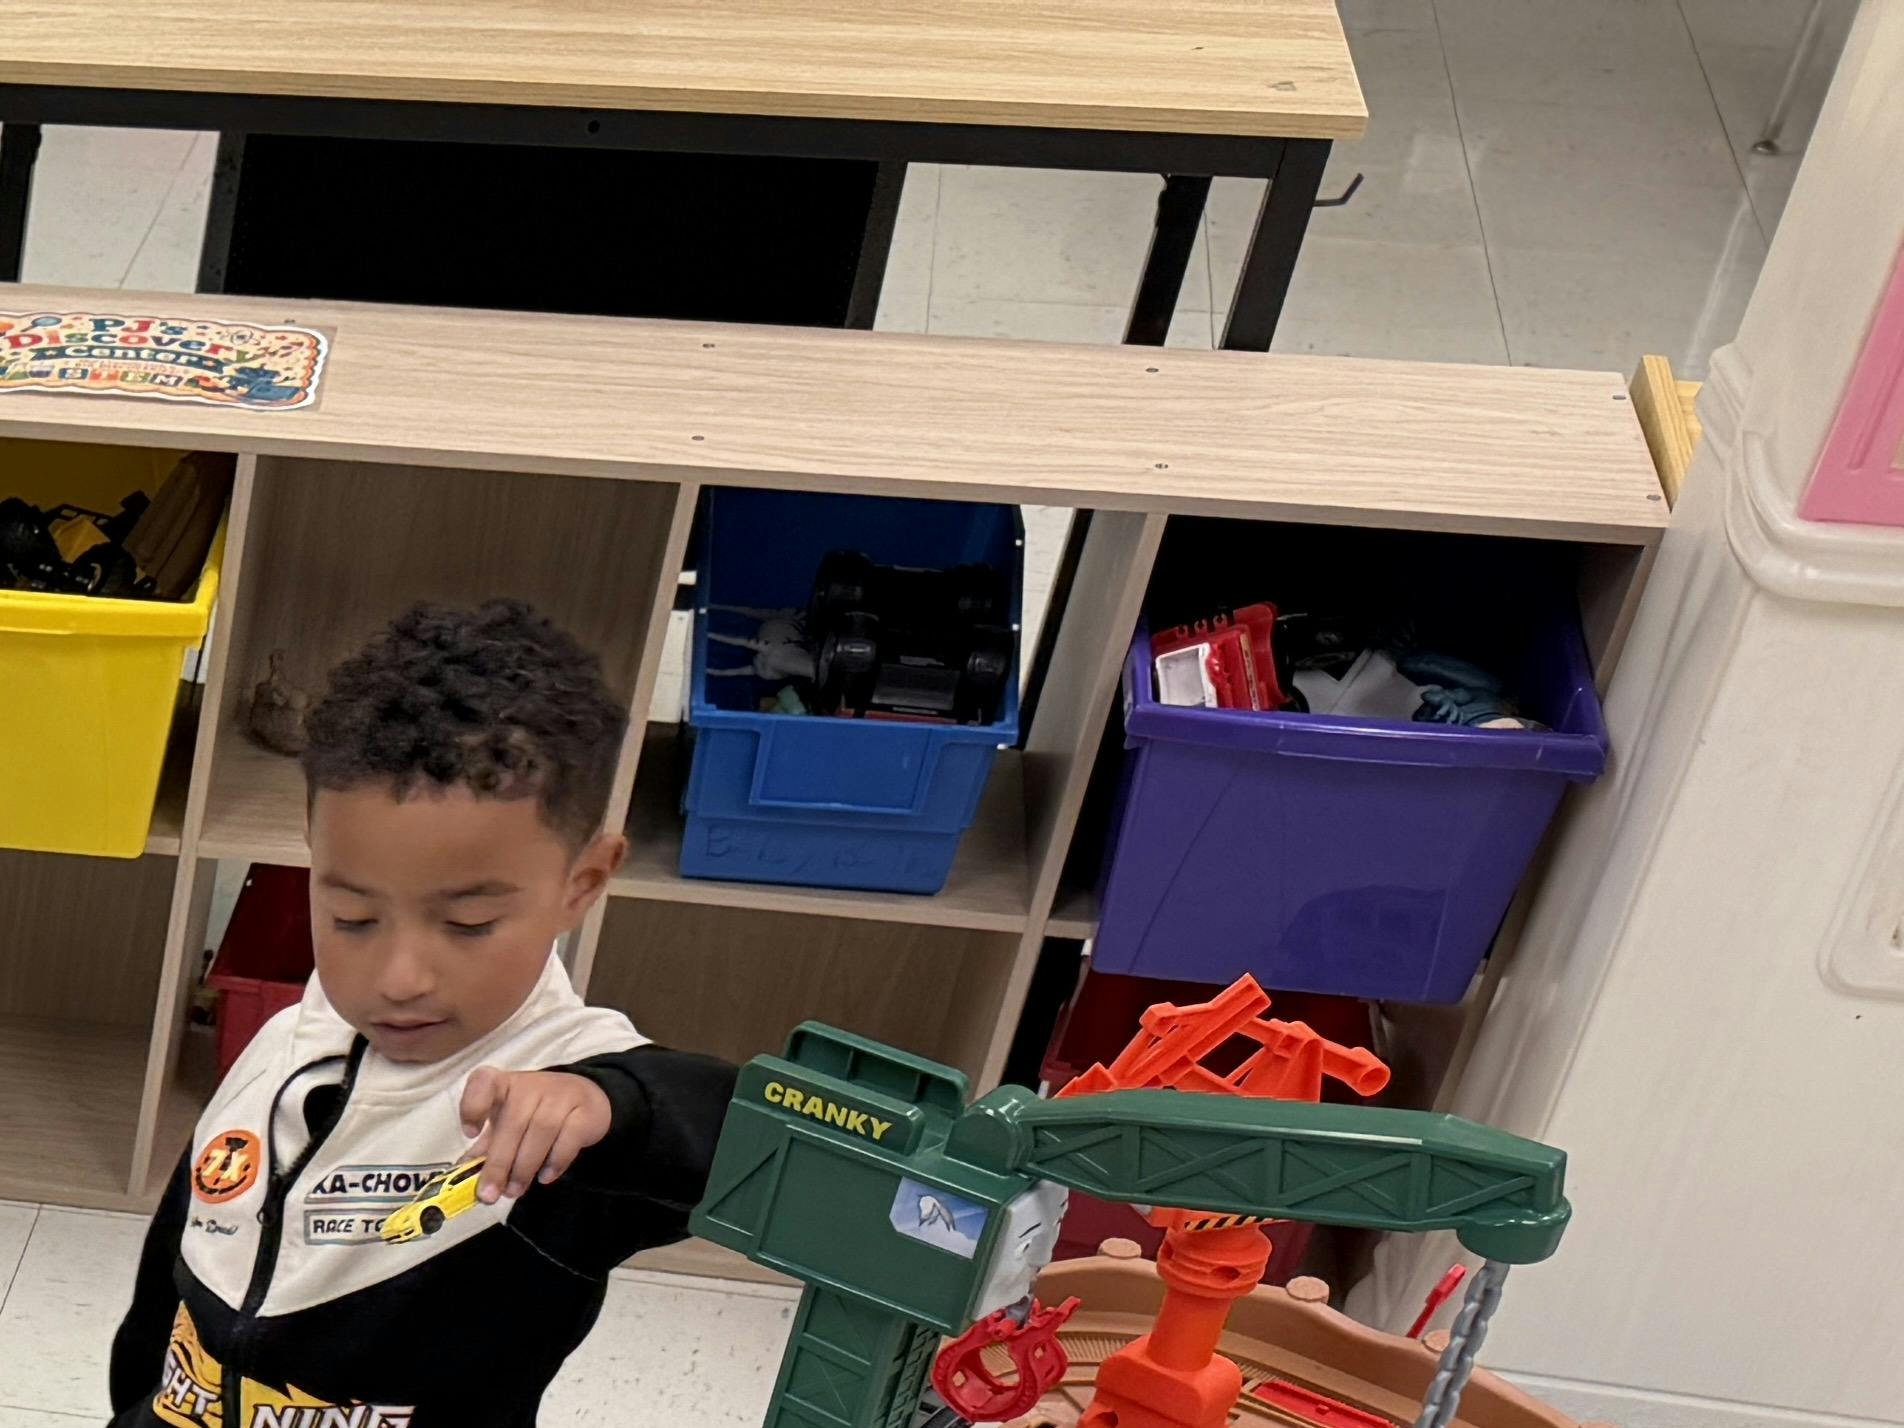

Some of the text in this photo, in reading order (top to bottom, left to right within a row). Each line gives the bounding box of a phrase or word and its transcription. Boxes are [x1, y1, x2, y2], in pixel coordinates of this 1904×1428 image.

[90, 318, 186, 336] PJ's
[5, 332, 257, 365] Discovery
[764, 1081, 893, 1140] CRANKY
[313, 1219, 355, 1234] RACE
